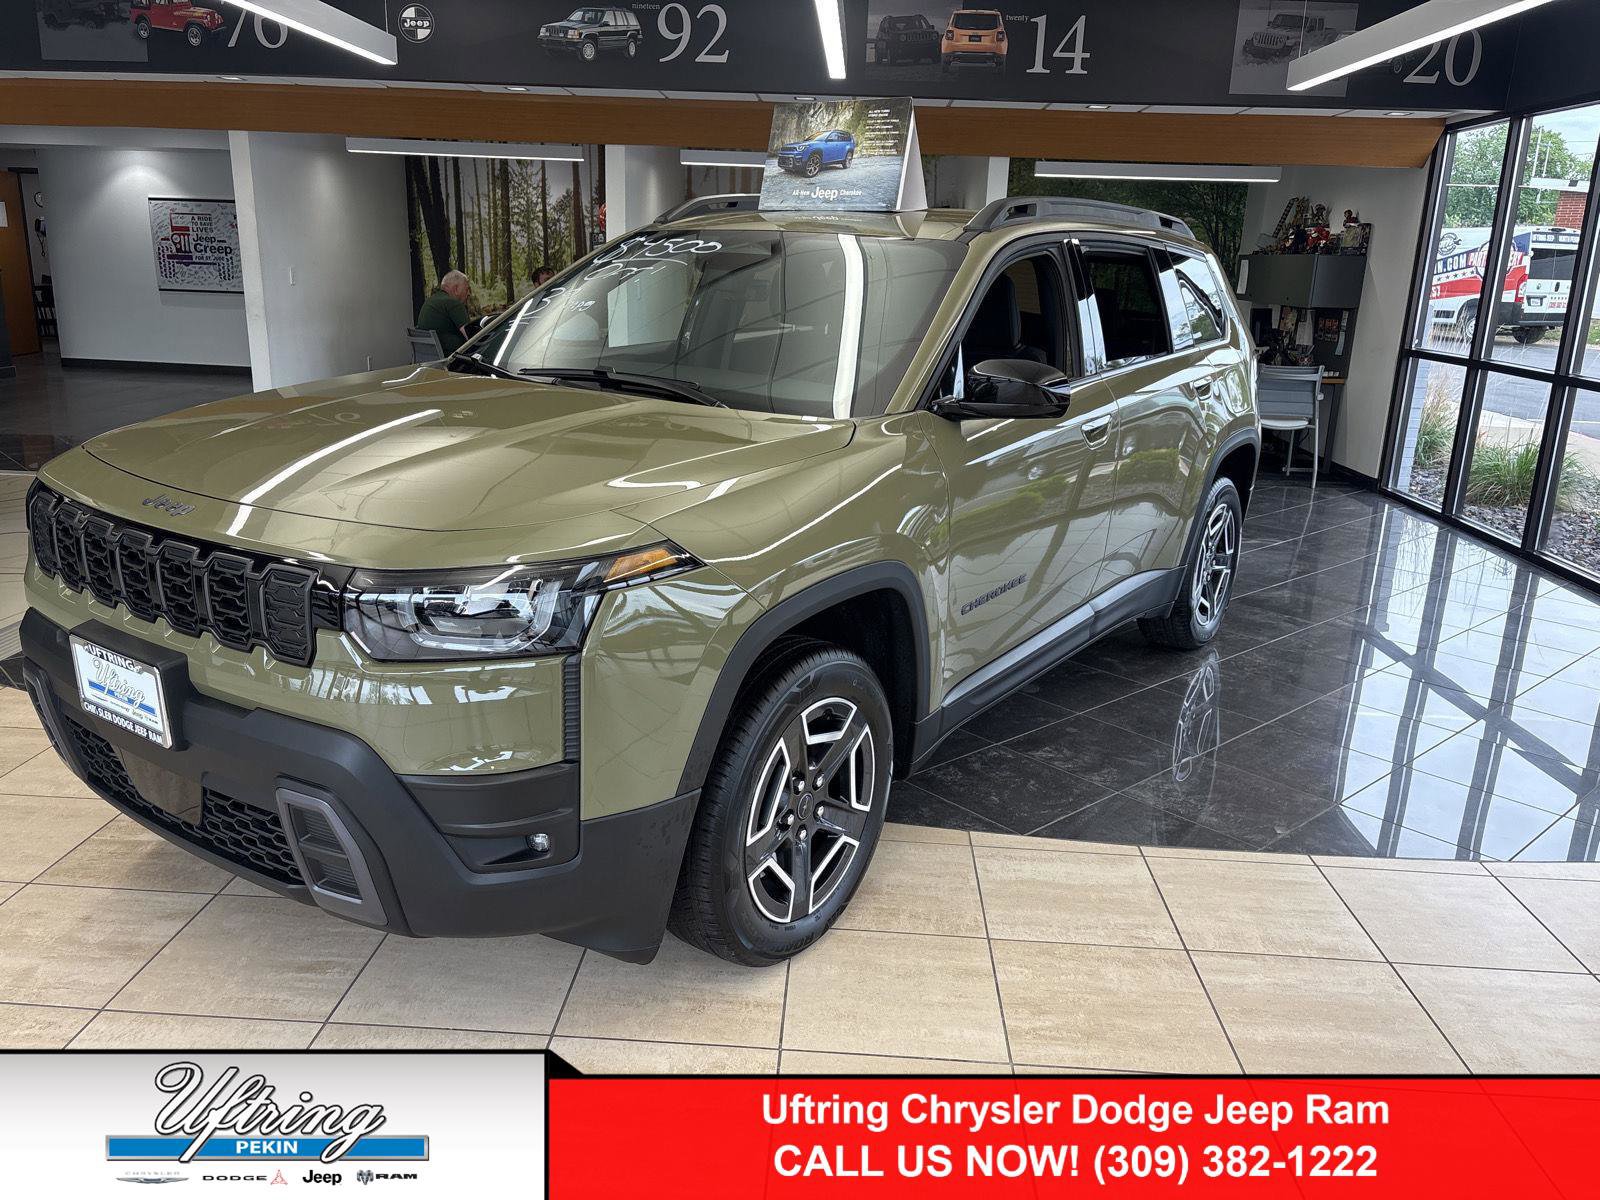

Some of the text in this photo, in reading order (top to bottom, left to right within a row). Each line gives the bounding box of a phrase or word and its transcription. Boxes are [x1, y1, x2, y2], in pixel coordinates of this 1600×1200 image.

[404, 19, 430, 28] Jeep
[657, 3, 730, 63] 92
[1026, 14, 1091, 75] 14
[811, 186, 839, 201] Jeep
[192, 233, 216, 244] Jeep
[193, 243, 233, 256] Creep
[142, 493, 196, 517] Jeep
[960, 573, 1027, 616] CHEROKEE
[88, 644, 134, 670] UFTRING
